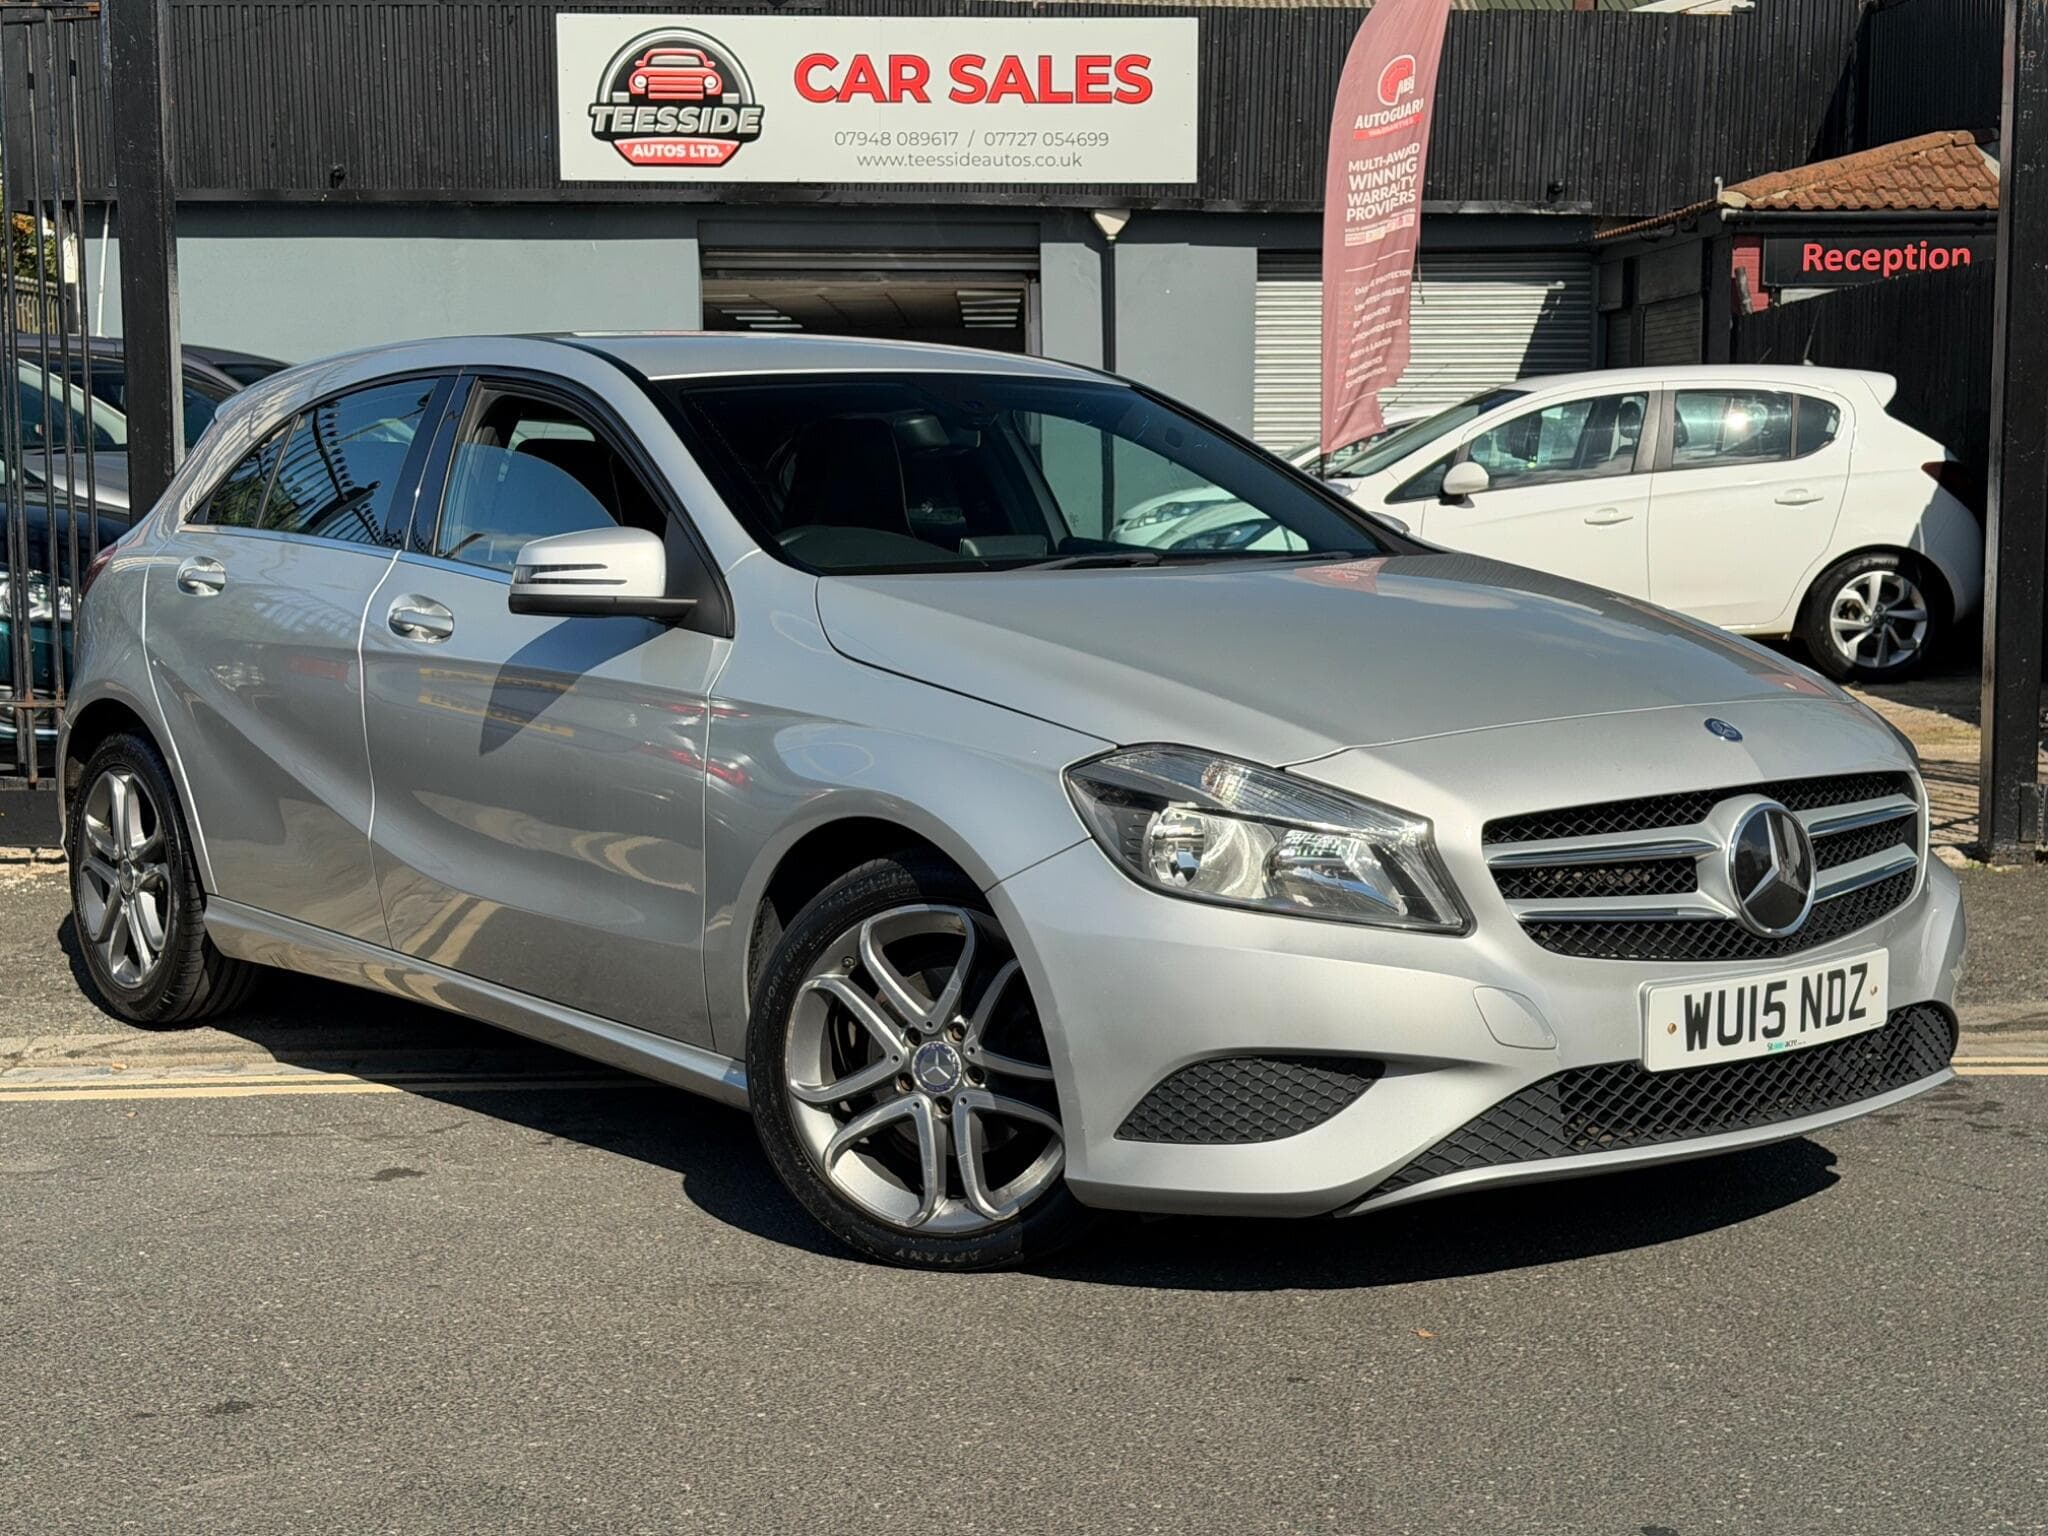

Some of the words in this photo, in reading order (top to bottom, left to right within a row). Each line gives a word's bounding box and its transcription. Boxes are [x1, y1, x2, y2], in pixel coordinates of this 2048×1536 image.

[794, 53, 931, 105] CAR
[949, 53, 1154, 105] SALES
[590, 105, 763, 134] TEESSIDE
[1354, 97, 1424, 130] AUTOGUAR
[631, 144, 686, 158] AUTOS
[689, 144, 723, 158] LTD.
[834, 131, 892, 147] 07948
[896, 131, 959, 147] 089617
[967, 130, 976, 148] /
[984, 131, 1038, 147] 07727
[1042, 131, 1109, 147] 054699
[857, 151, 1083, 168] www.teessideautos.co.uk
[1802, 240, 1972, 278] Reception
[1684, 979, 1788, 1052] WU15
[1800, 961, 1869, 1034] NDZ
